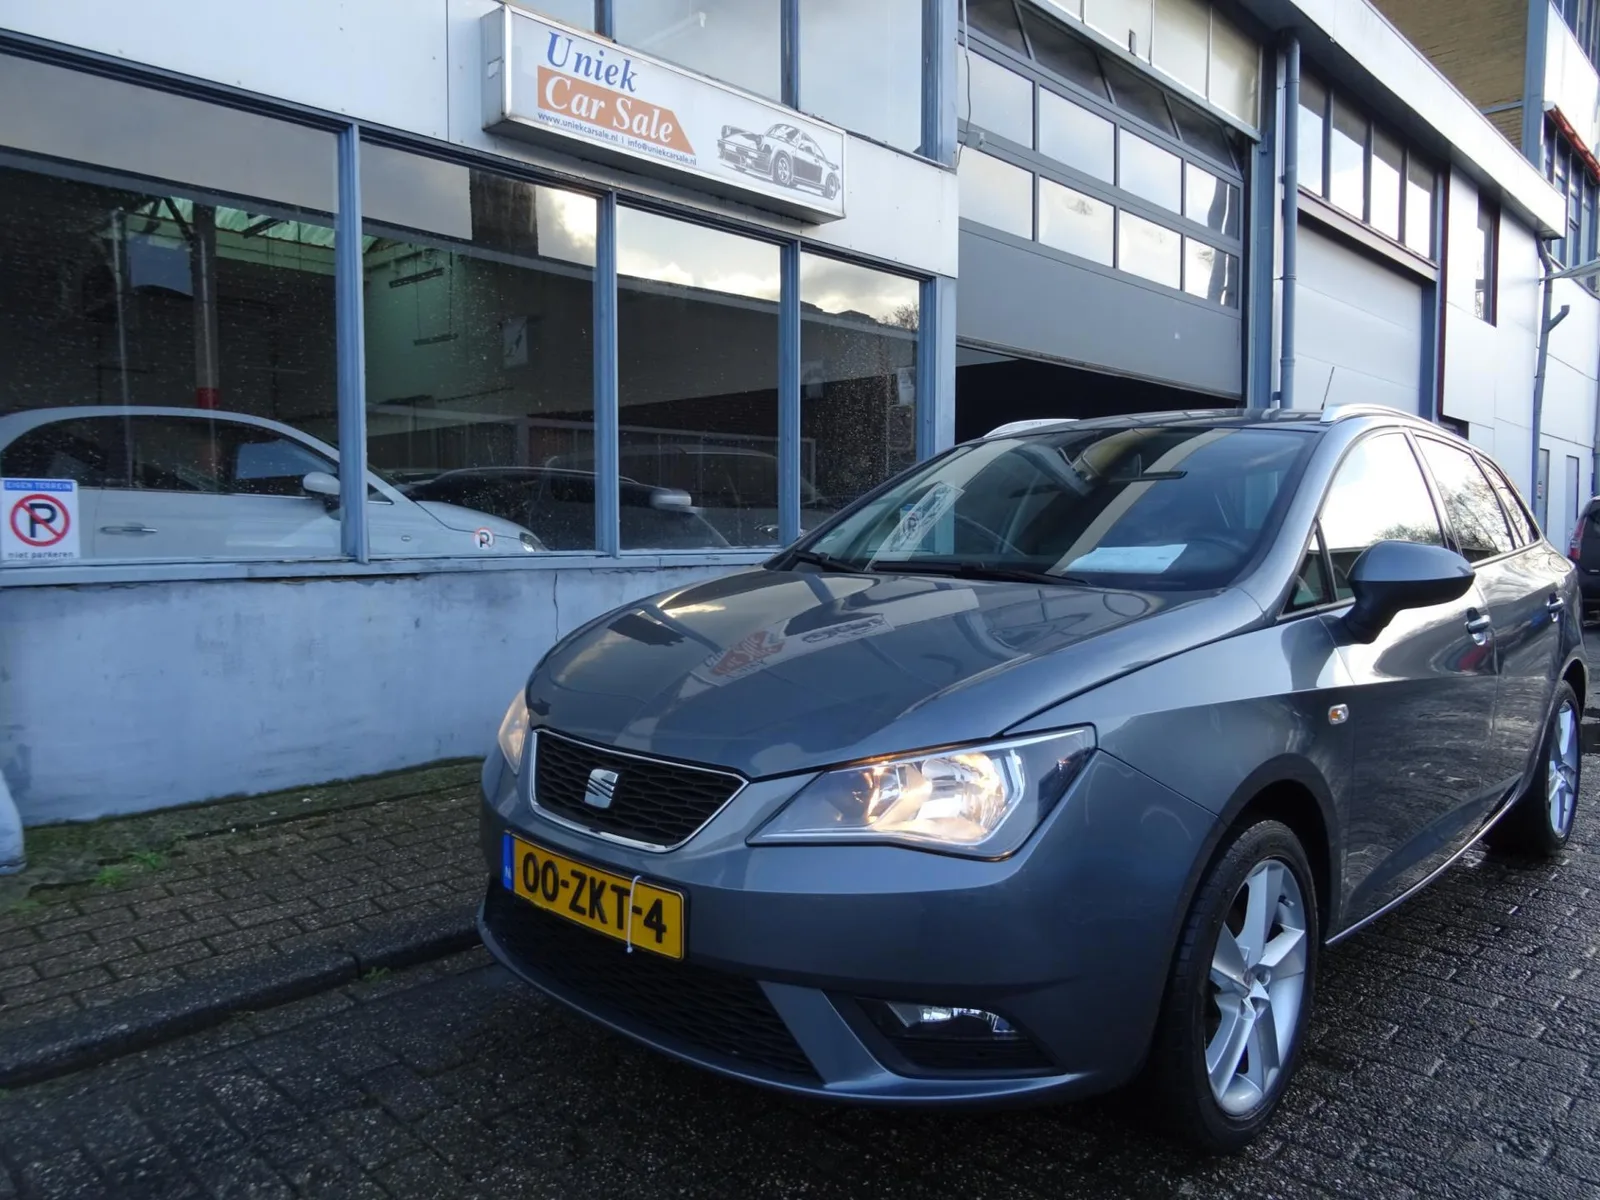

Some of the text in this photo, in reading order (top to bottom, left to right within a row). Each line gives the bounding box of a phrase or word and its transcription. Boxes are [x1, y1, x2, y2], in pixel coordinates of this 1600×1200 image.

[547, 31, 639, 93] Uniek
[537, 111, 619, 143] www.uniekcarsale.nl
[627, 139, 697, 166] info@uniekcarsale.nl
[545, 76, 674, 143] Car Sale
[31, 551, 74, 559] parkeren
[522, 852, 667, 944] 00-ZKT-4
